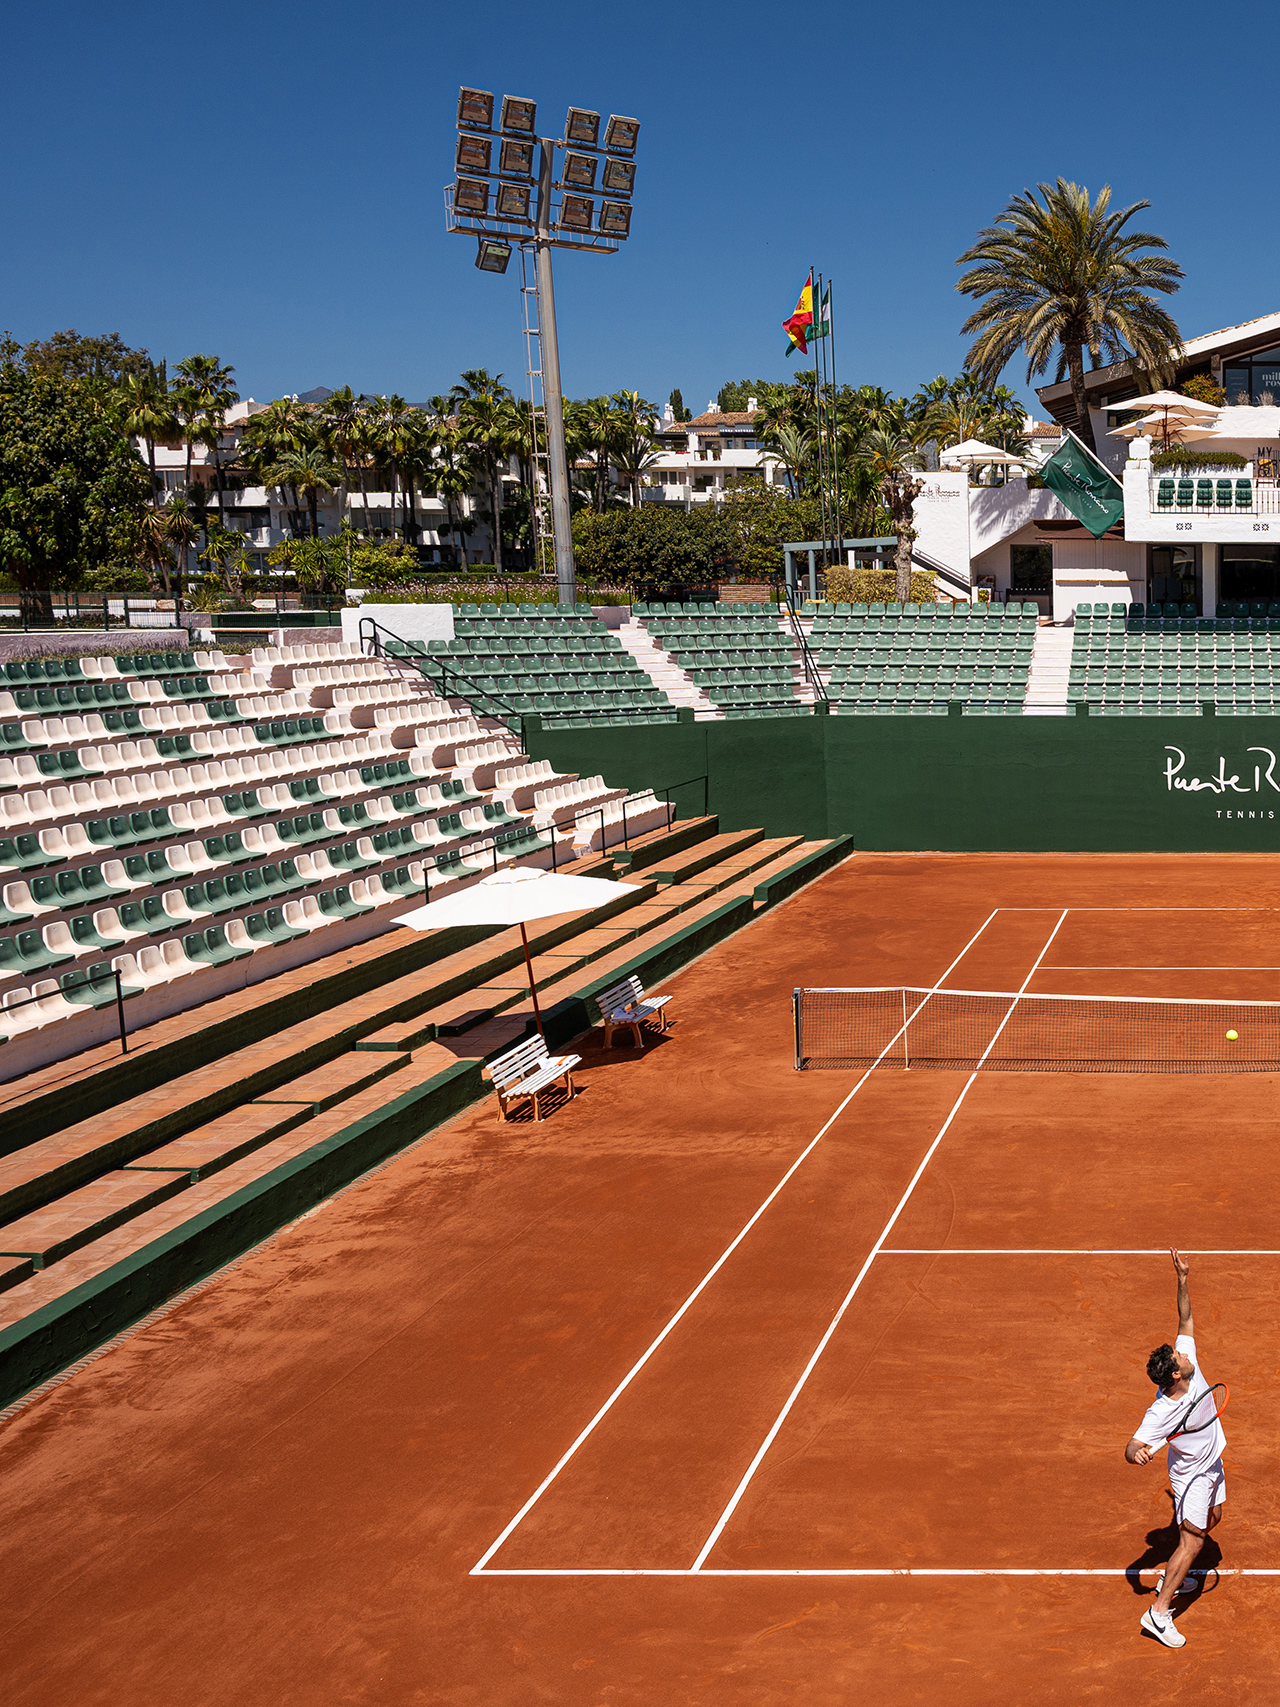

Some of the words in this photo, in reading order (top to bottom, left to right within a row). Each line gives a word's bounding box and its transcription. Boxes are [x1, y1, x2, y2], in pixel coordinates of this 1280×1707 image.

[1257, 446, 1273, 457] MY
[1061, 458, 1081, 487] Puente
[1081, 476, 1109, 514] Romano
[1162, 745, 1251, 794] Puente
[1216, 810, 1276, 819] TENNIS
